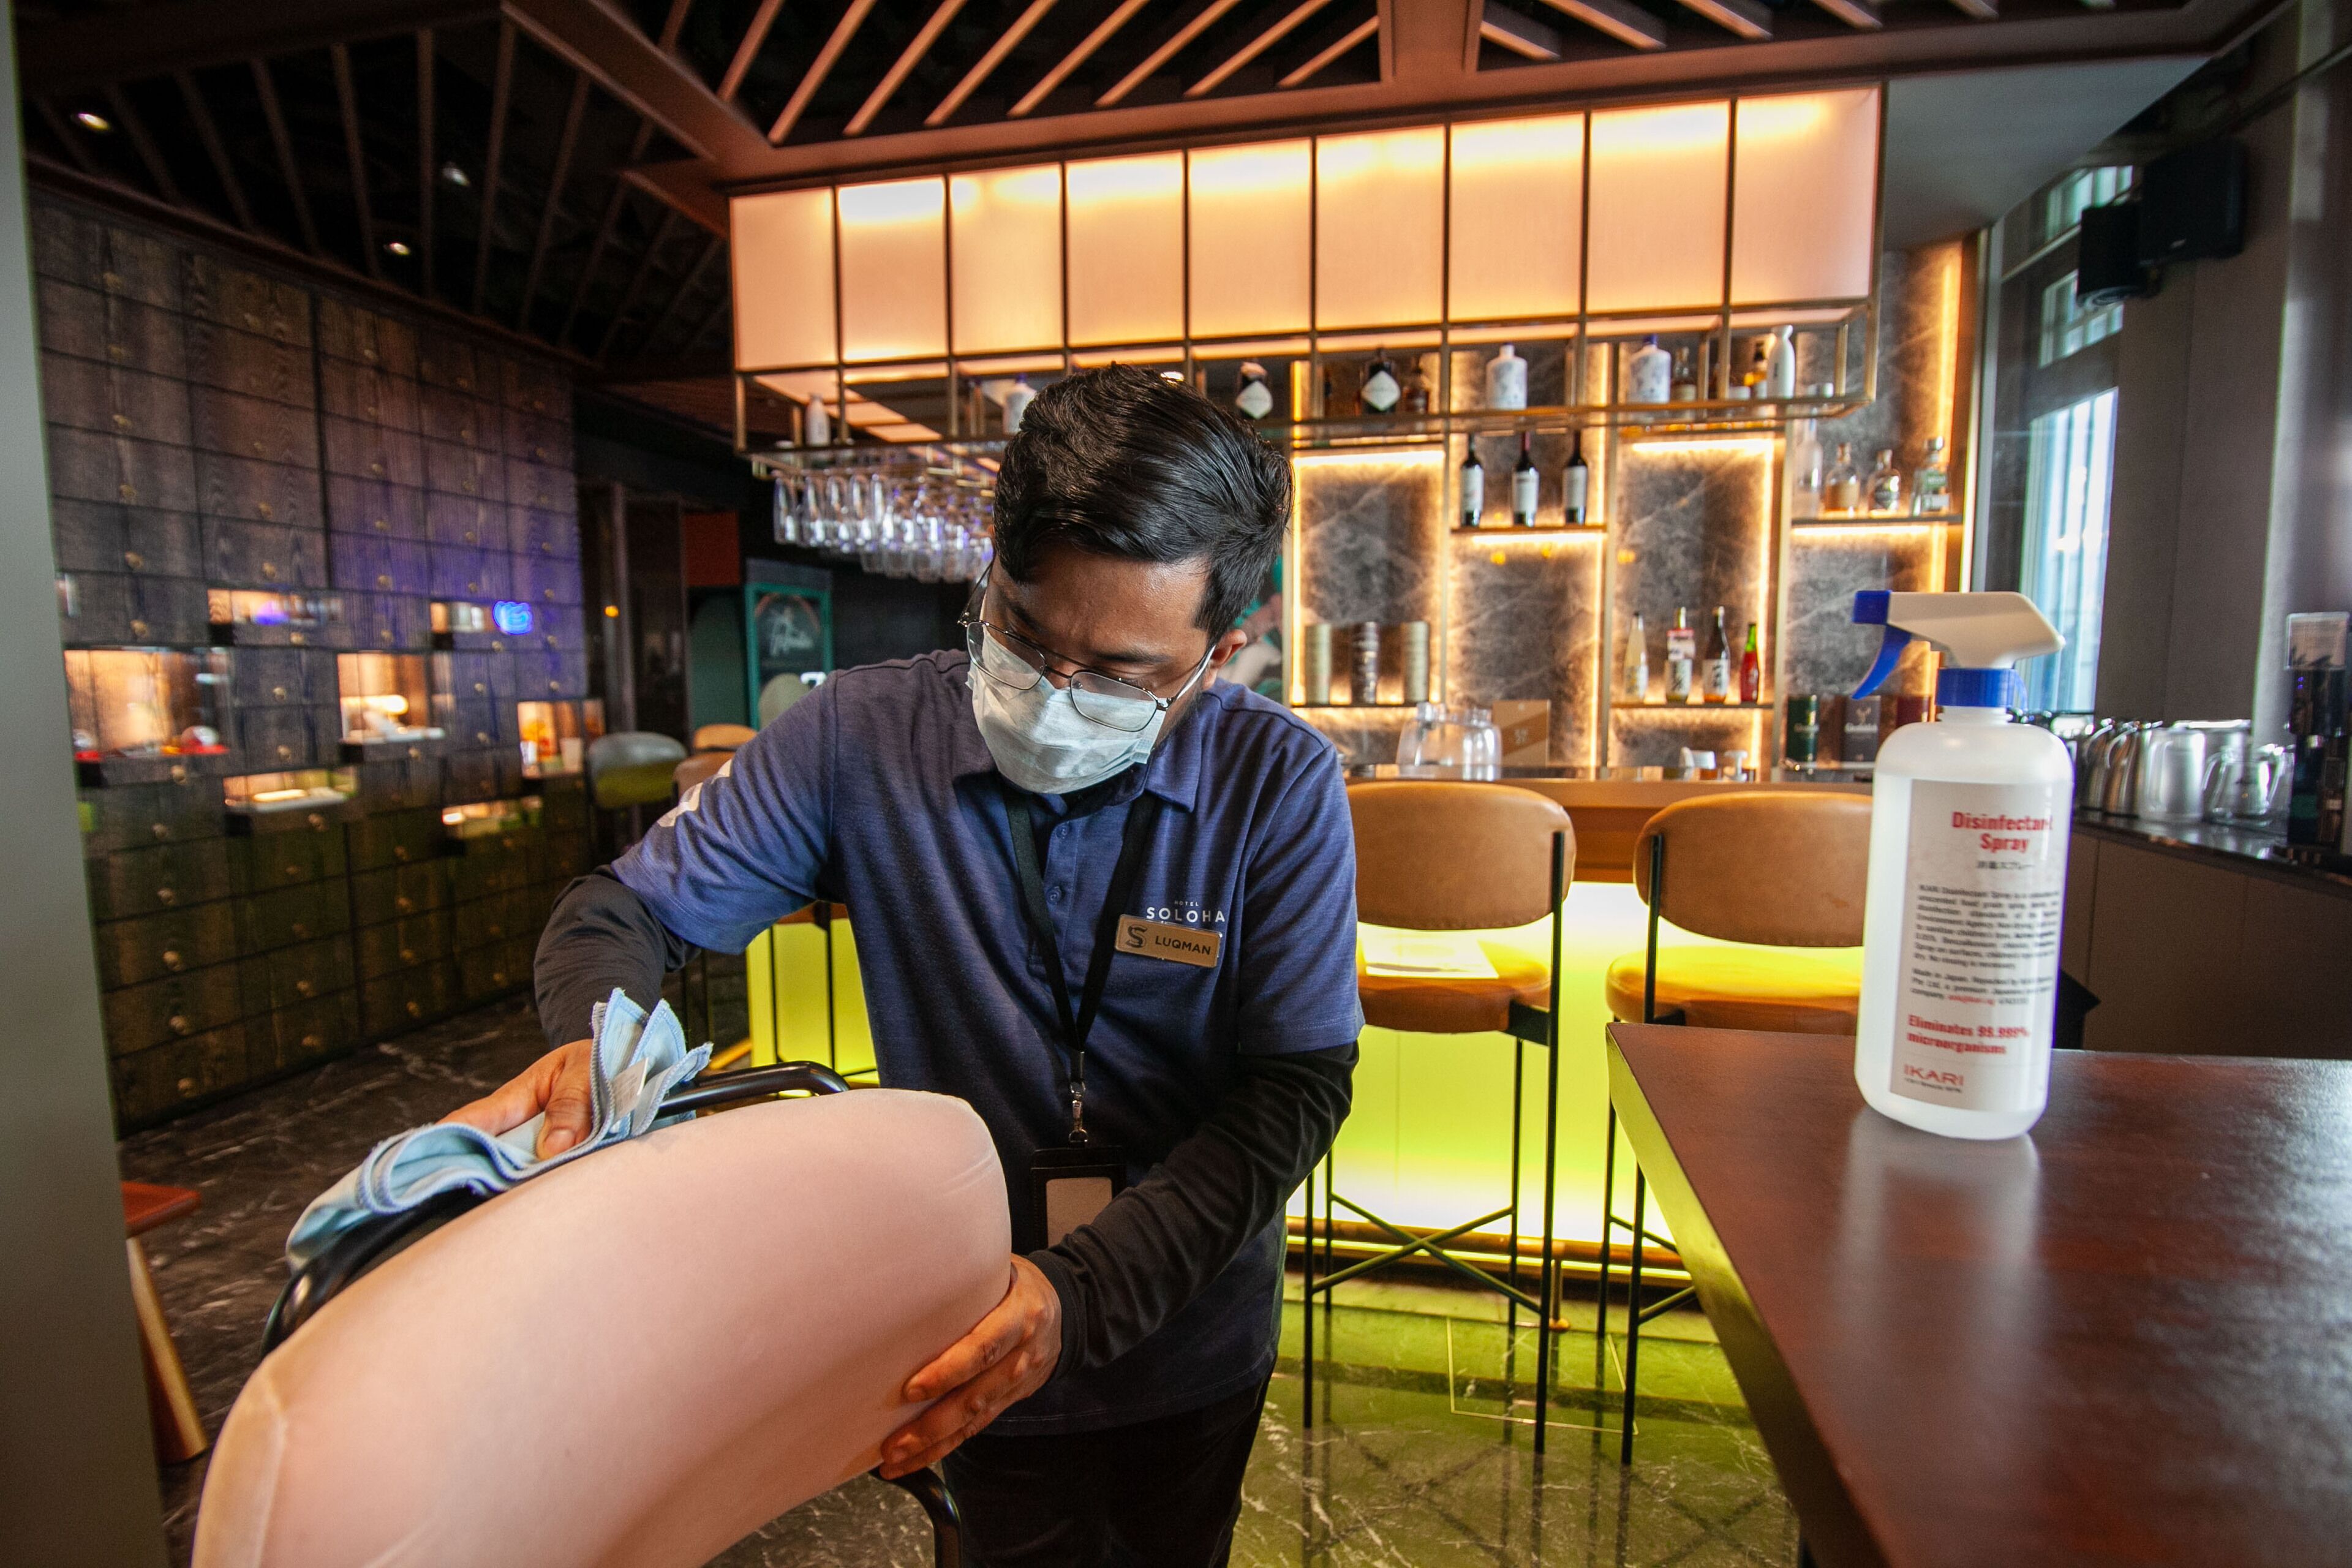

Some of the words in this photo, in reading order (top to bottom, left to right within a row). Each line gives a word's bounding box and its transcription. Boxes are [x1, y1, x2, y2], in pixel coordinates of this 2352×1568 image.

[1980, 833, 2029, 853] Spray
[1146, 907, 1225, 922] SOLOHA
[1155, 935, 1211, 956] LUQMAN
[1909, 1014, 1973, 1037] Eliminates
[1907, 1033, 2007, 1054] microorganisms
[1904, 1064, 1964, 1086] IKARI
